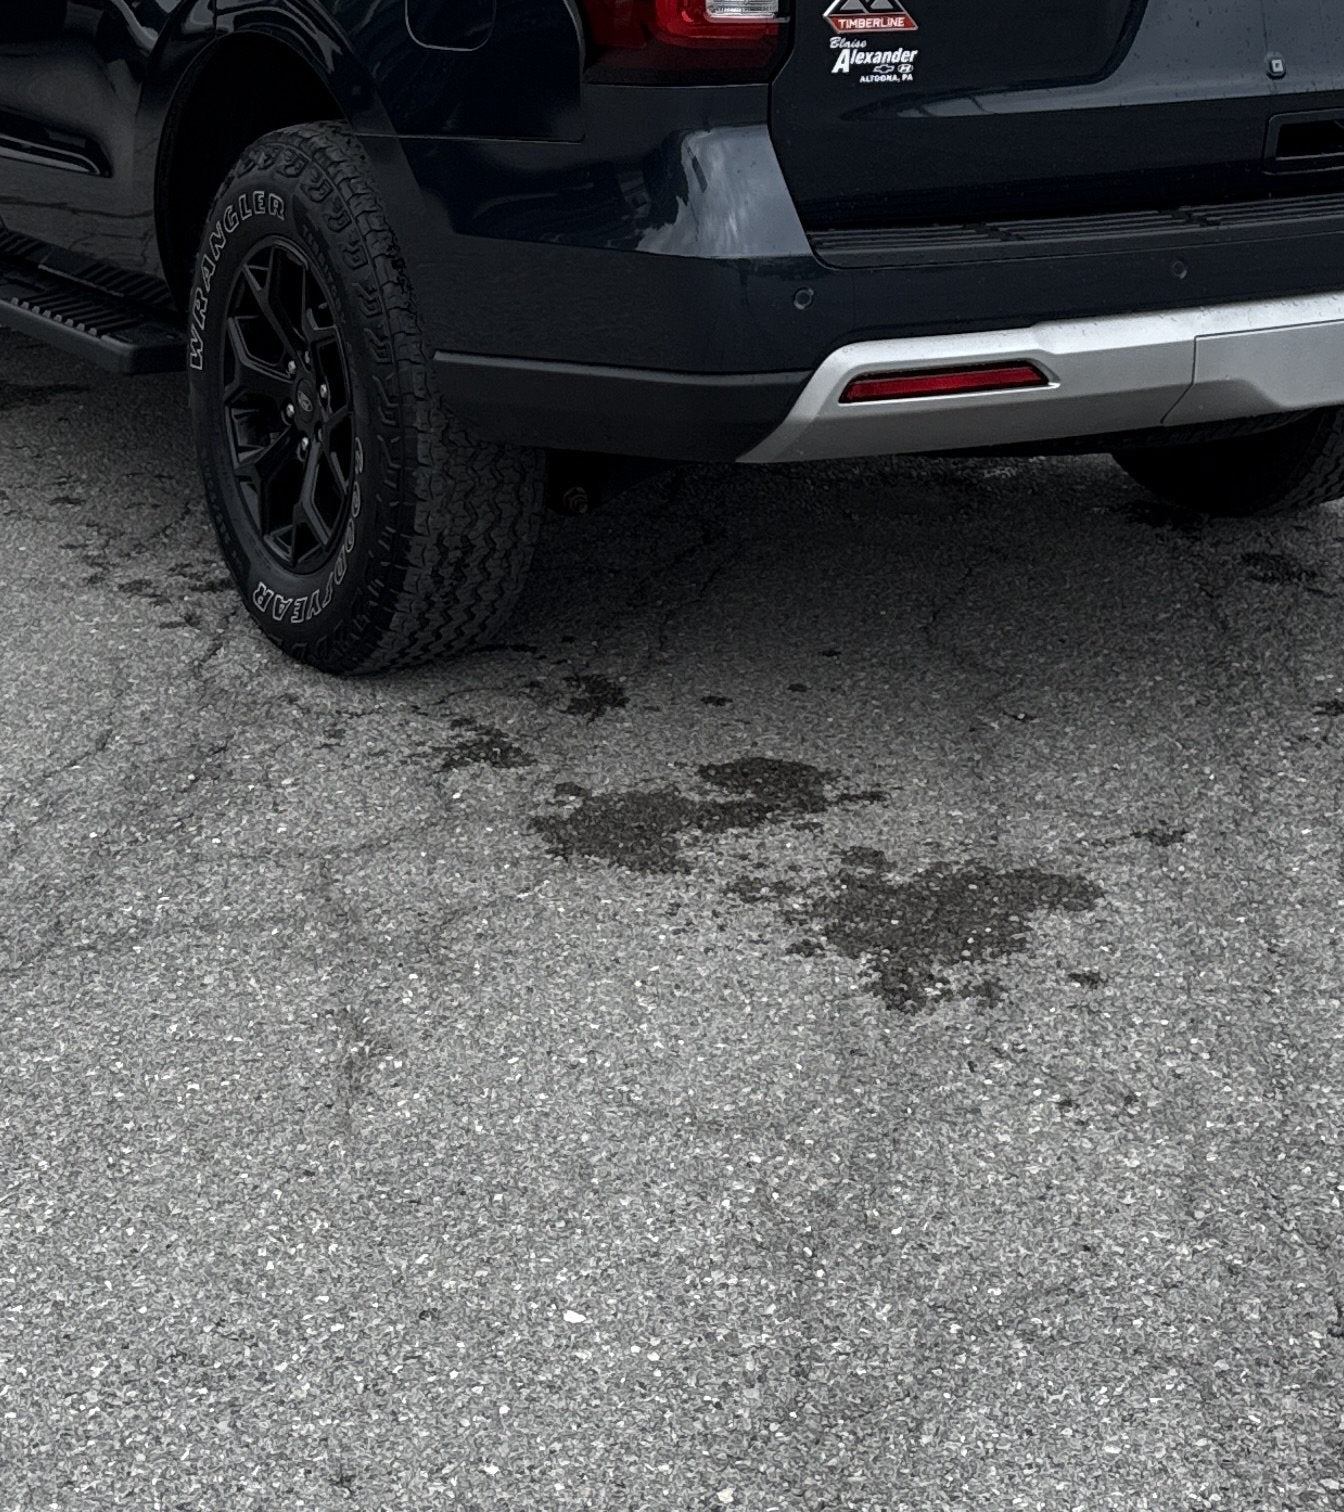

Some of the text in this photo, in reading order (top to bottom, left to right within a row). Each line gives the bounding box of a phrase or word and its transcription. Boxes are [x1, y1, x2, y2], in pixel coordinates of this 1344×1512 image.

[838, 17, 906, 29] TIMBERLINE
[829, 36, 867, 48] Blaise
[831, 47, 918, 73] Alexander
[189, 190, 286, 370] WRANGLER
